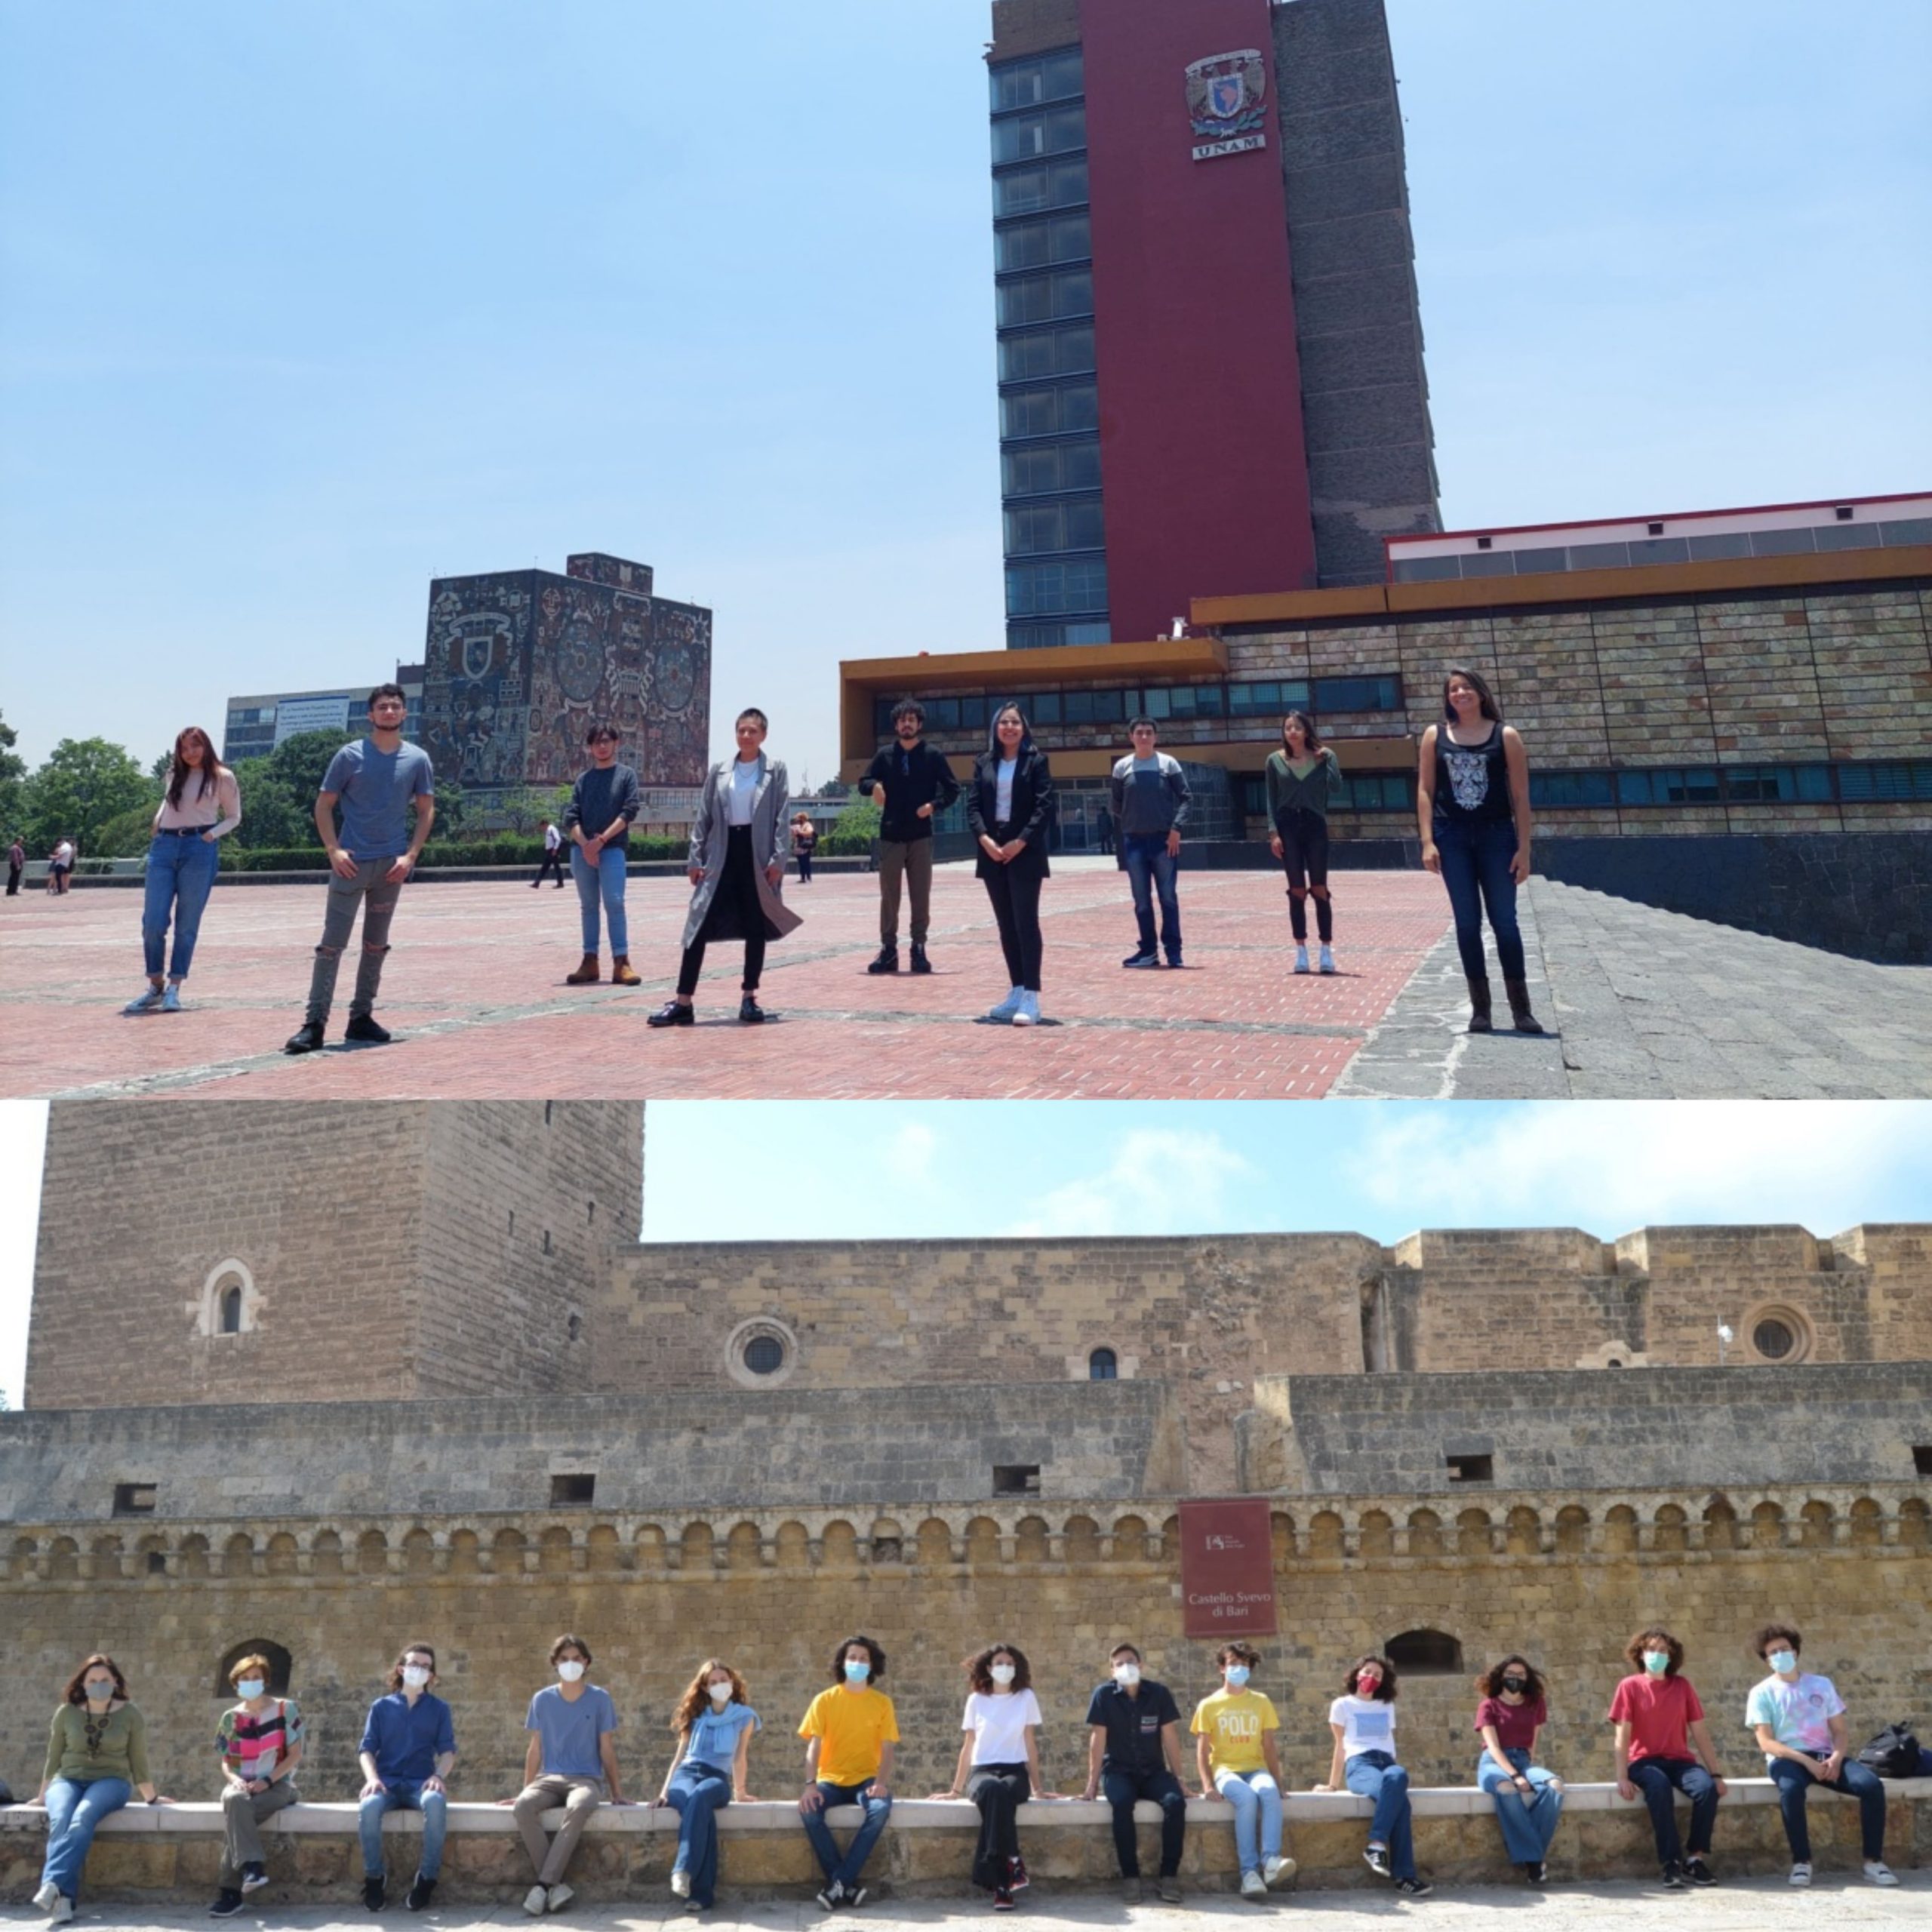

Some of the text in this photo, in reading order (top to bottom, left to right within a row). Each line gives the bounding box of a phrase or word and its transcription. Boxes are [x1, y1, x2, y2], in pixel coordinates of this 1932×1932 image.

[1198, 137, 1259, 157] UNAM
[1189, 1592, 1271, 1604] Castello Svevo
[1212, 1605, 1248, 1617] di Bari
[1217, 1715, 1258, 1736] POLO
